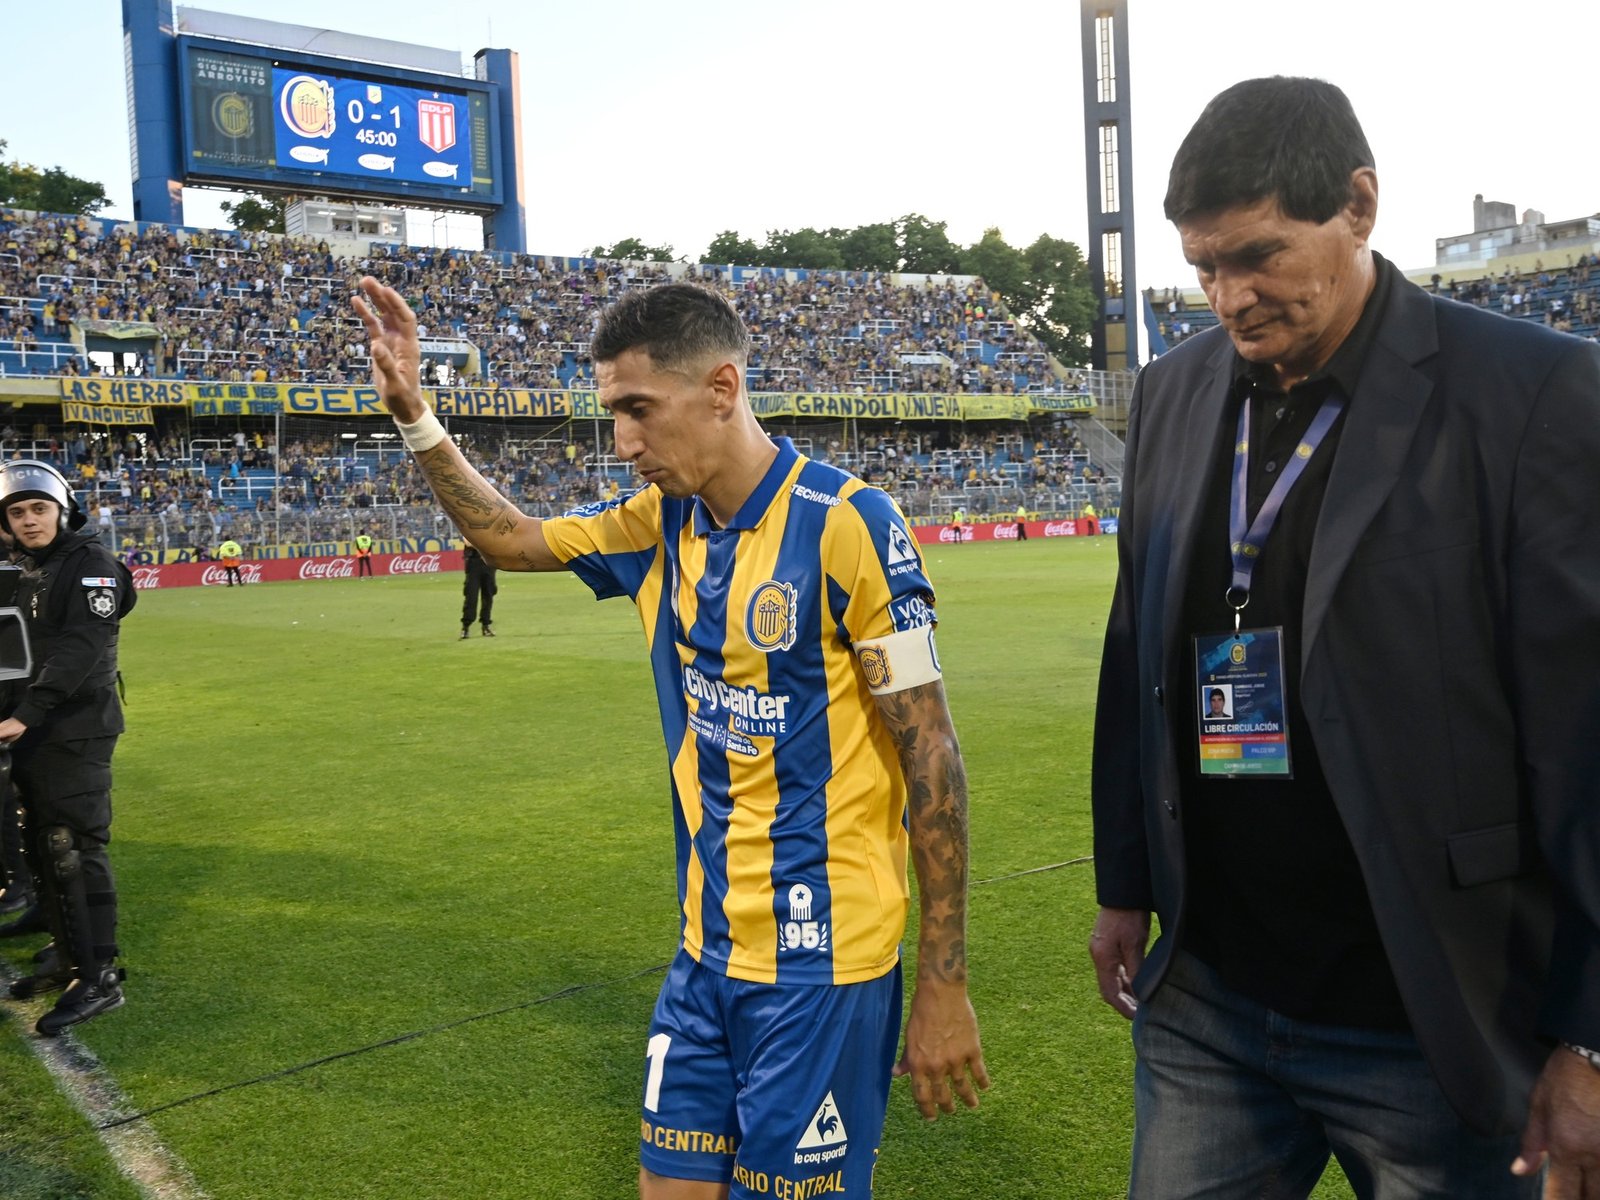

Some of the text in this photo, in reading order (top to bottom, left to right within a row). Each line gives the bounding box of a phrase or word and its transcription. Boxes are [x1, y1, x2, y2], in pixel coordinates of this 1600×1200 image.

[197, 62, 265, 78] GIGANTE DE
[198, 69, 265, 86] ARROYITO
[347, 99, 364, 124] 0
[389, 105, 400, 129] 1
[355, 128, 397, 147] 45:00
[60, 380, 183, 404] LAS HERAS
[287, 386, 385, 413] GER
[1028, 395, 1092, 409] VIADUCTO
[435, 390, 566, 416] EMPALME
[749, 394, 792, 414] RMUDEZ
[795, 395, 898, 417] GRANDOLI
[64, 404, 151, 423] IVANOWSKI
[939, 525, 973, 542] Cocaola
[993, 523, 1018, 539] Coca-C
[1044, 521, 1076, 537] Coca-Cola
[201, 563, 264, 586] CocaCola
[300, 558, 354, 580] Coca-Cola
[389, 554, 441, 575] Coca-Cola
[734, 716, 787, 734] ONLINE
[1204, 721, 1279, 733] LIBRE CIRCULACIÓN
[726, 738, 758, 755] Santa Fe
[784, 921, 820, 950] 95
[655, 1126, 738, 1155] CENTRAL
[794, 1144, 848, 1165] le coq sportif
[774, 1170, 846, 1200] CENTRAL
